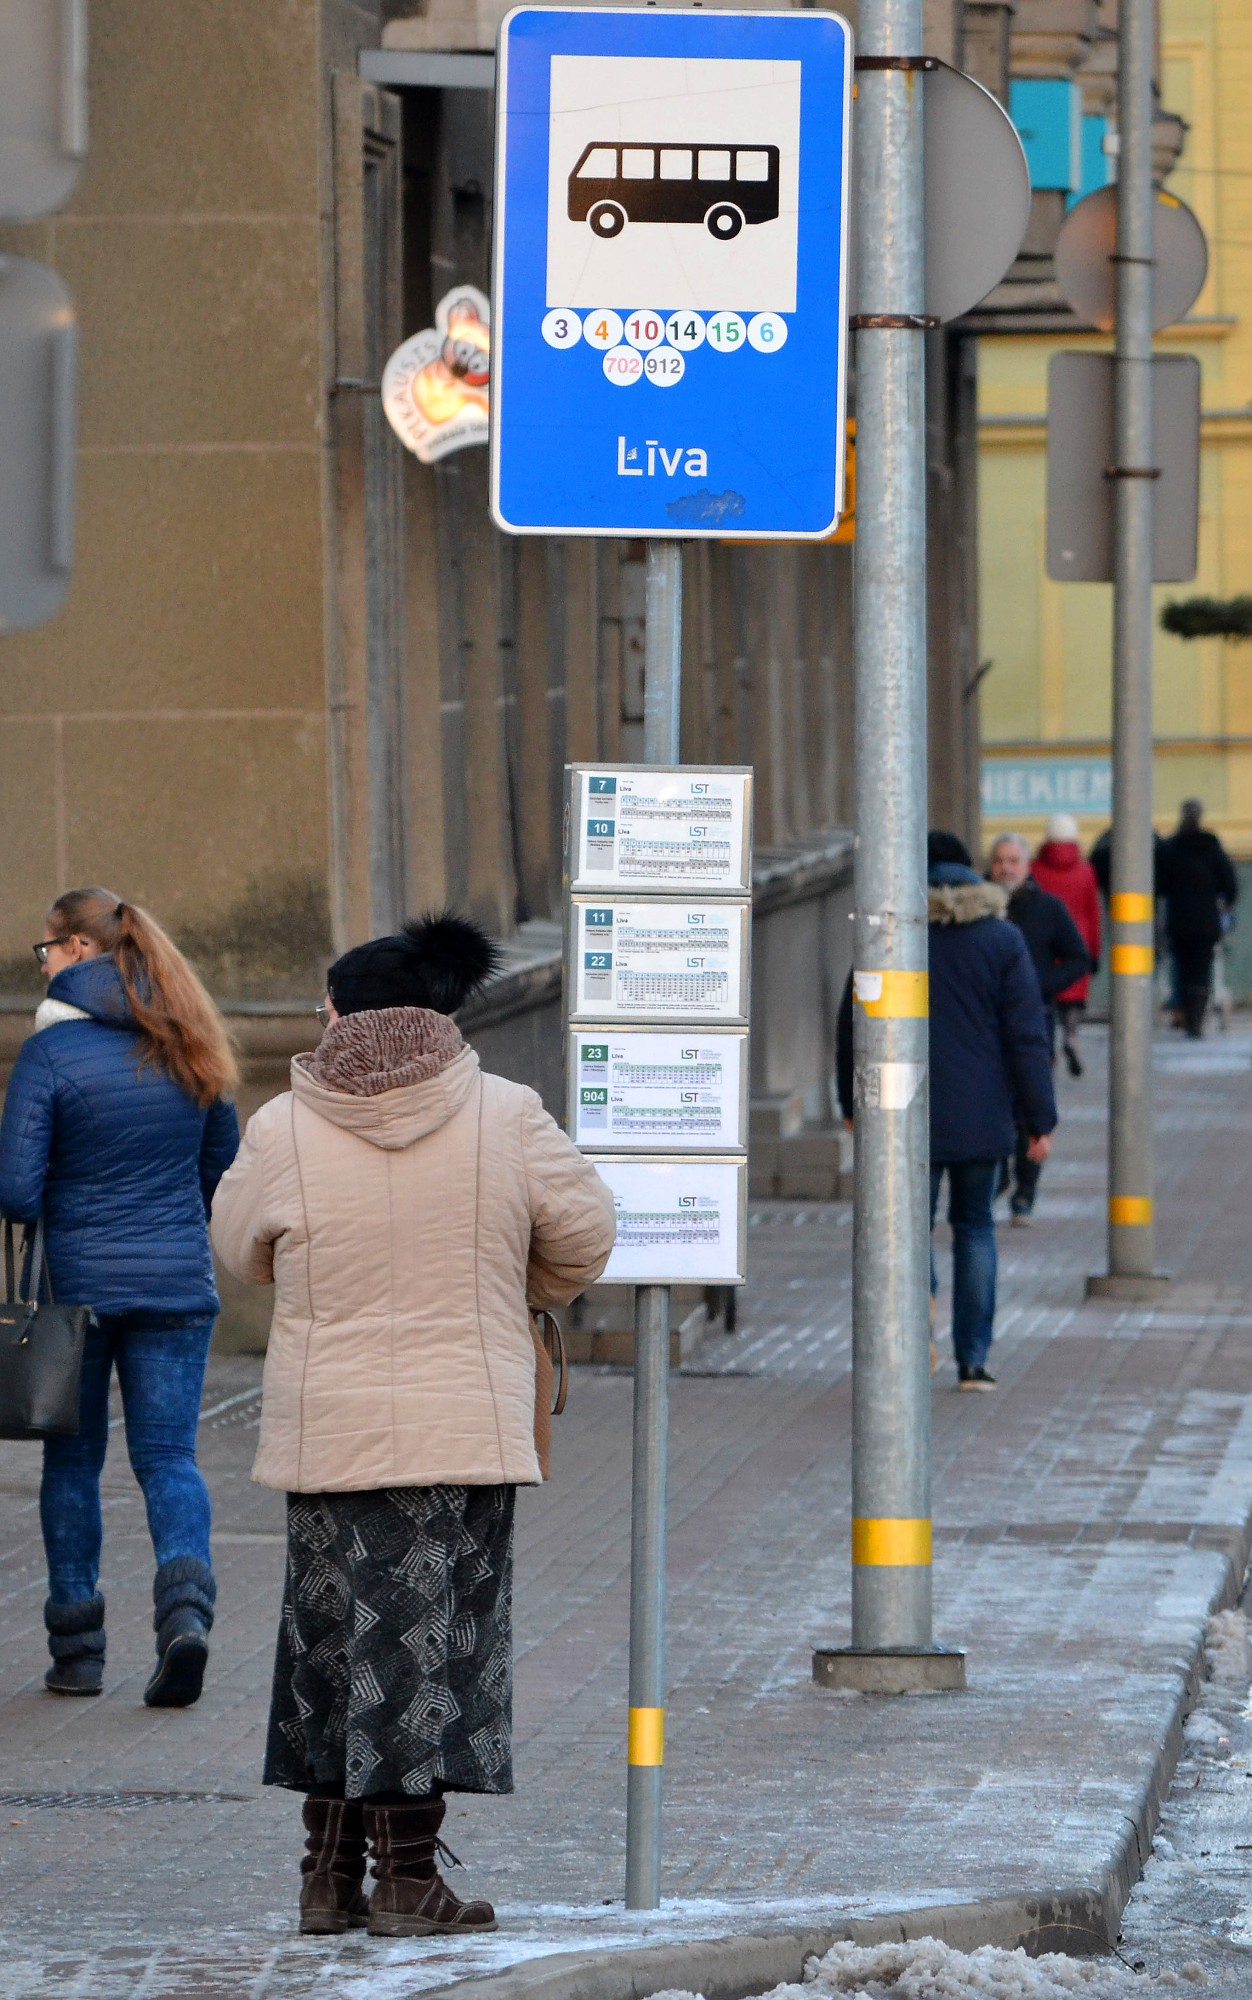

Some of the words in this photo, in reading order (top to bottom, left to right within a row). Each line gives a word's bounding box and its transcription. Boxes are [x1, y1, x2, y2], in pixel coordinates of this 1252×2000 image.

[554, 318, 569, 339] 3
[594, 320, 609, 341] 4
[630, 320, 659, 340] 10
[669, 320, 698, 341] 14
[711, 321, 740, 342] 15
[760, 322, 775, 343] 6
[605, 357, 640, 374] 702
[646, 358, 681, 375] 912
[617, 436, 708, 477] Līva
[599, 780, 606, 791] 7
[691, 783, 709, 794] LST
[594, 823, 608, 834] 10
[689, 826, 708, 837] LST
[592, 912, 605, 923] 11
[687, 913, 706, 924] LST
[591, 956, 606, 967] 22
[686, 957, 705, 968] LST
[587, 1048, 602, 1059] 23
[681, 1049, 699, 1060] LST
[583, 1091, 605, 1102] 904
[680, 1092, 699, 1103] LST
[679, 1196, 697, 1207] LST
